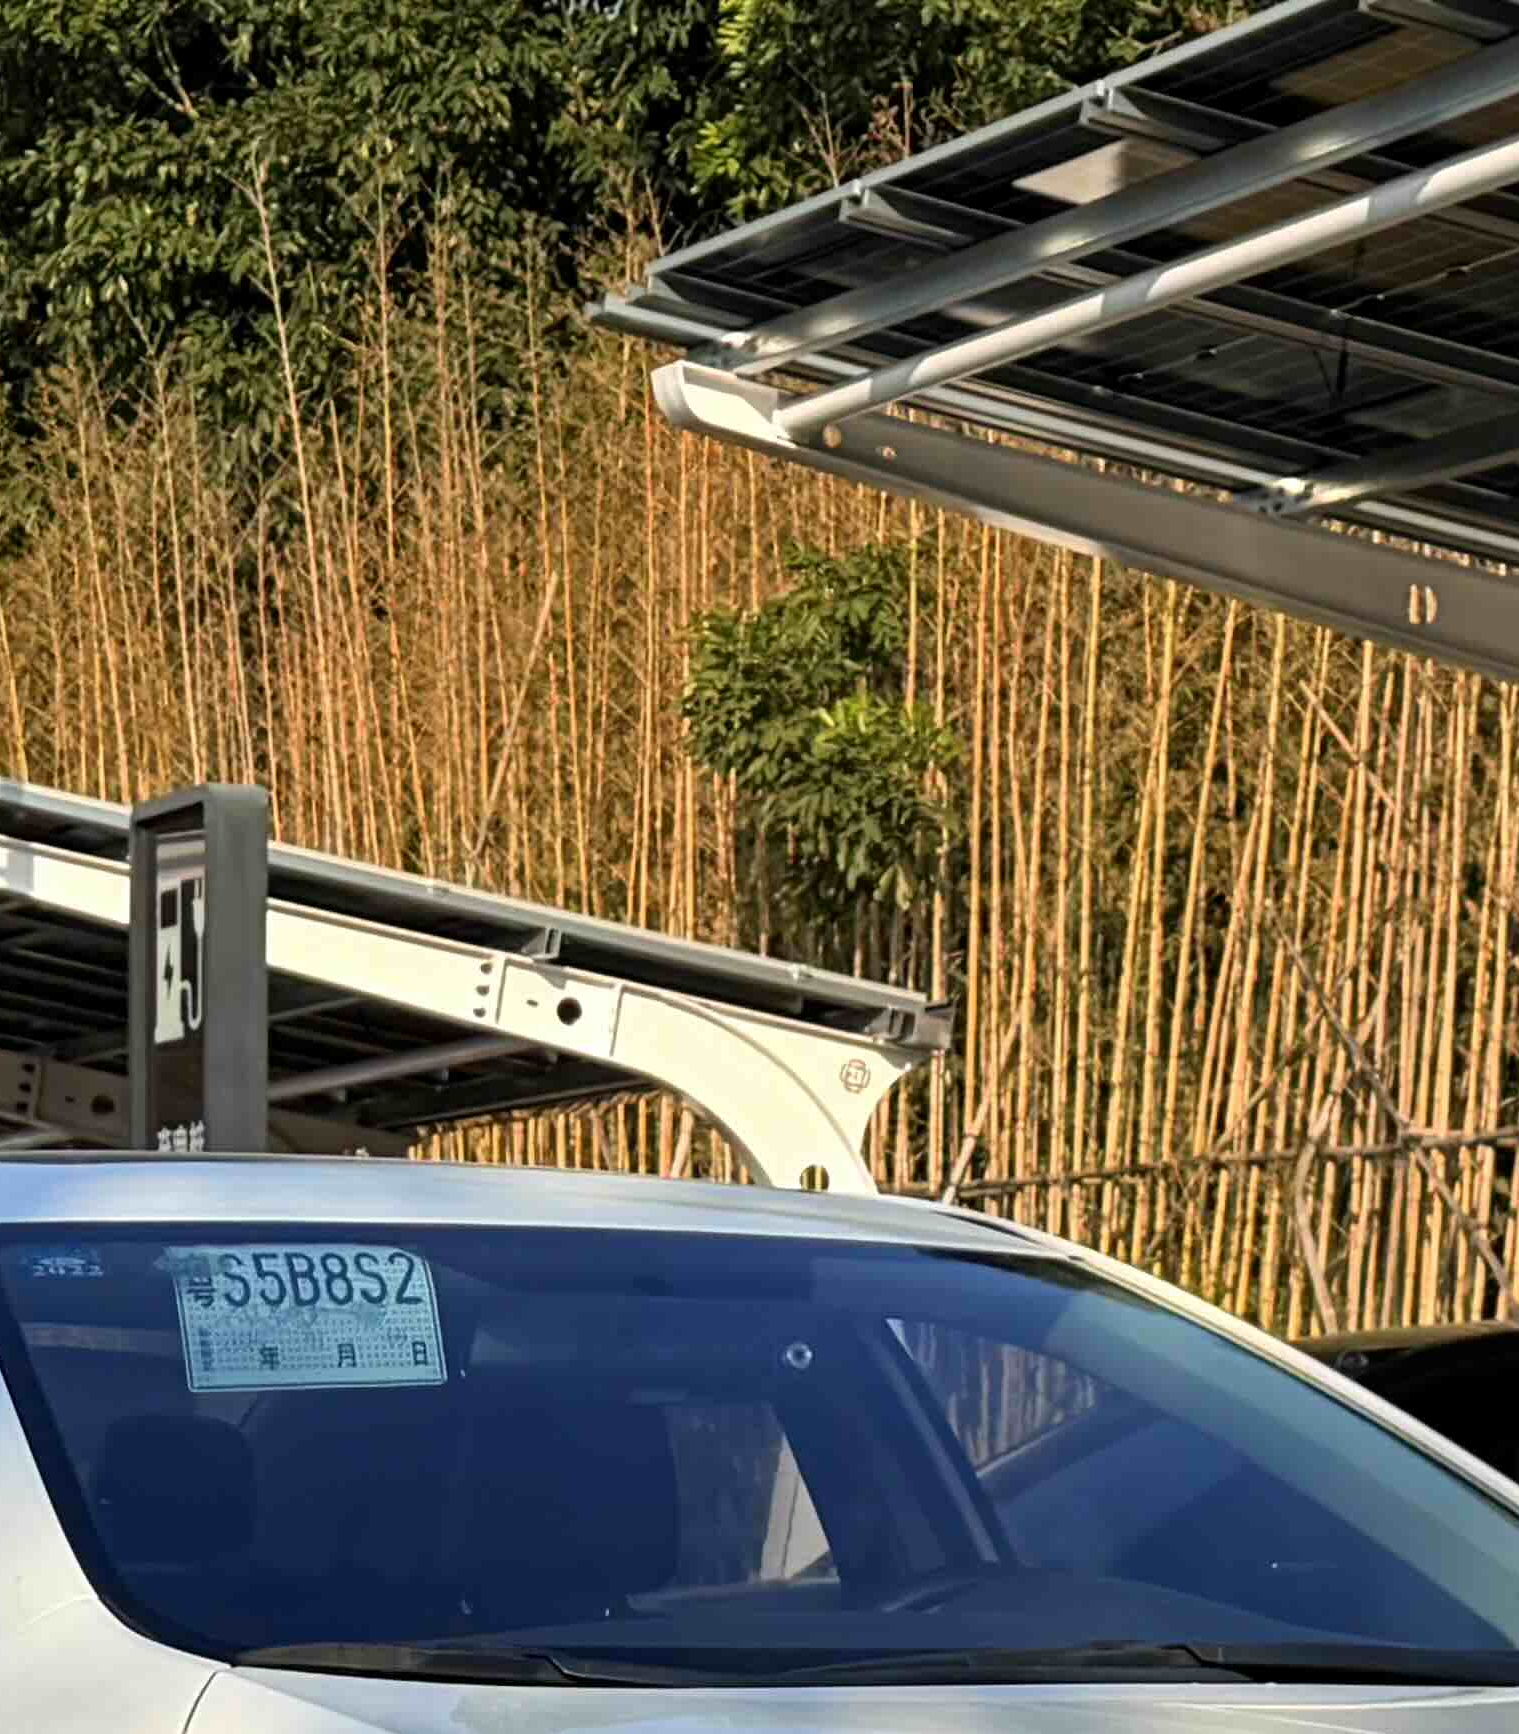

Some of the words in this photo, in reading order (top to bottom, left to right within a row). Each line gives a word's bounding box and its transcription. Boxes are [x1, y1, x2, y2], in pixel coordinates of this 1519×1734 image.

[260, 1344, 281, 1371] 年
[337, 1343, 357, 1368] 月
[412, 1341, 428, 1366] 日
